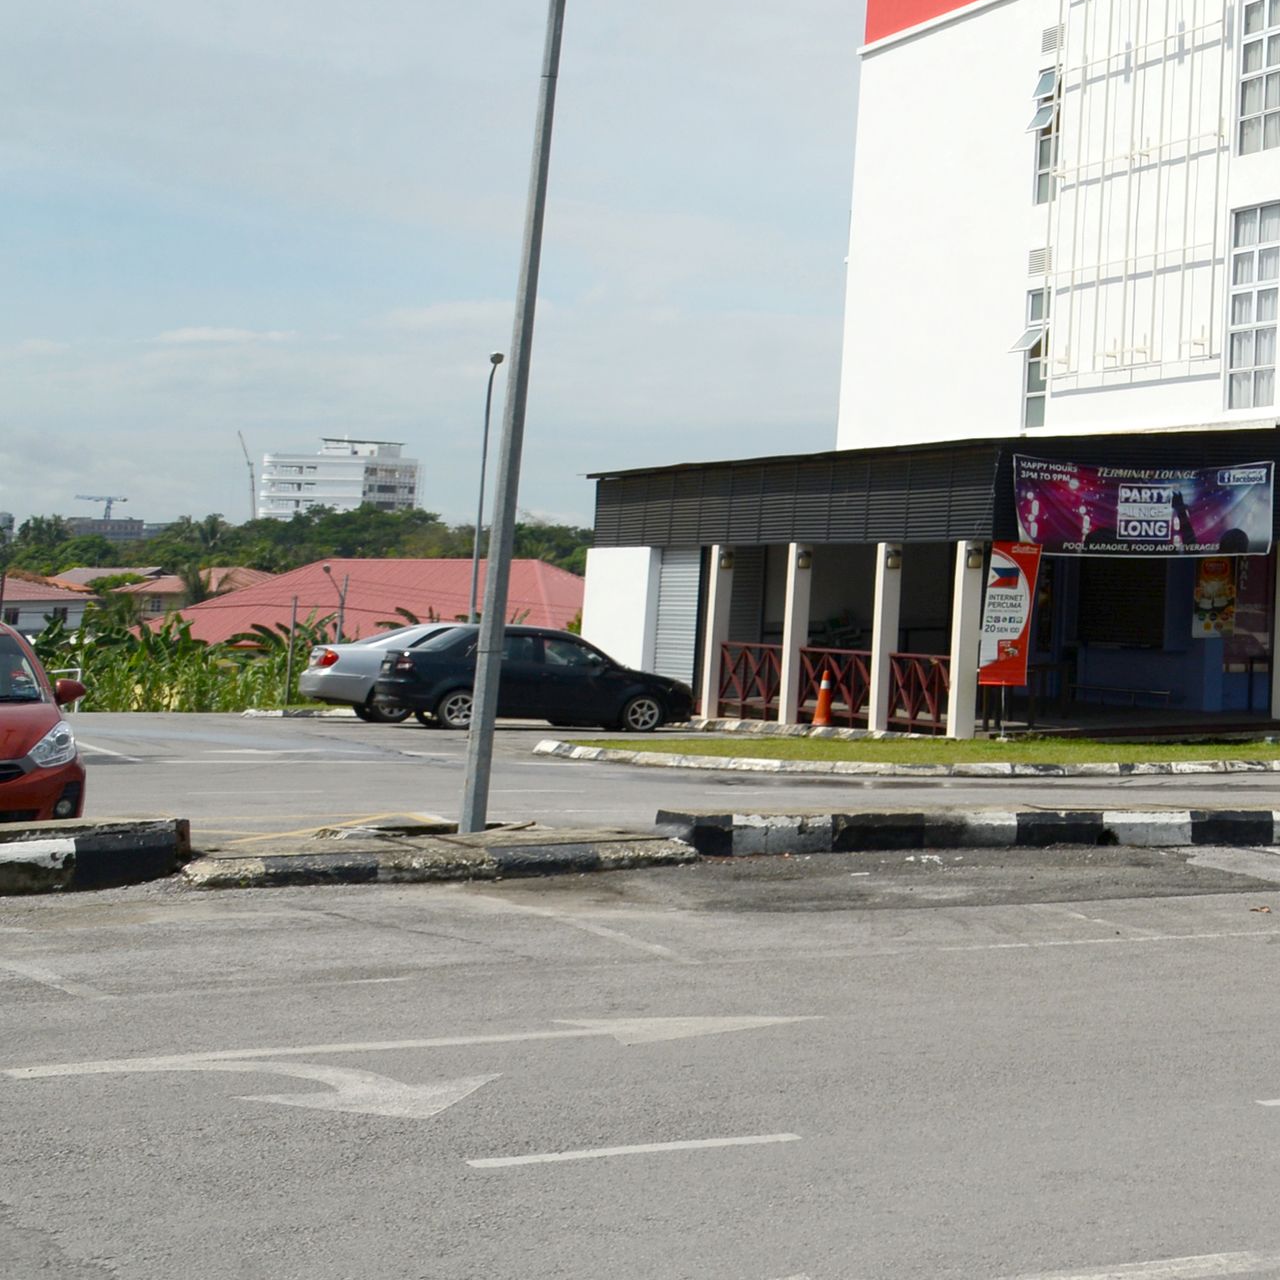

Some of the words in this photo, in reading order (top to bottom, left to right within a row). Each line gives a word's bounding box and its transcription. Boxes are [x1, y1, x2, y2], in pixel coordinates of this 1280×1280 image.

[1020, 460, 1048, 470] HAPPY
[1049, 463, 1078, 473] HOURS
[1020, 470, 1038, 479] 3PM
[1040, 472, 1051, 480] TO
[1052, 473, 1071, 482] 9PM
[1097, 467, 1154, 479] TERMINAL
[1154, 470, 1199, 480] LOUNGE
[1120, 488, 1169, 504] PARTY
[1120, 521, 1168, 536] LONG
[1062, 543, 1086, 552] POOL,
[1089, 544, 1129, 552] KARAOKE,
[1131, 544, 1155, 552] FOOD
[1156, 544, 1174, 552] AND
[1176, 543, 1220, 551] BEVERAGES
[988, 594, 1024, 602] INTERNET
[984, 624, 996, 633] 20
